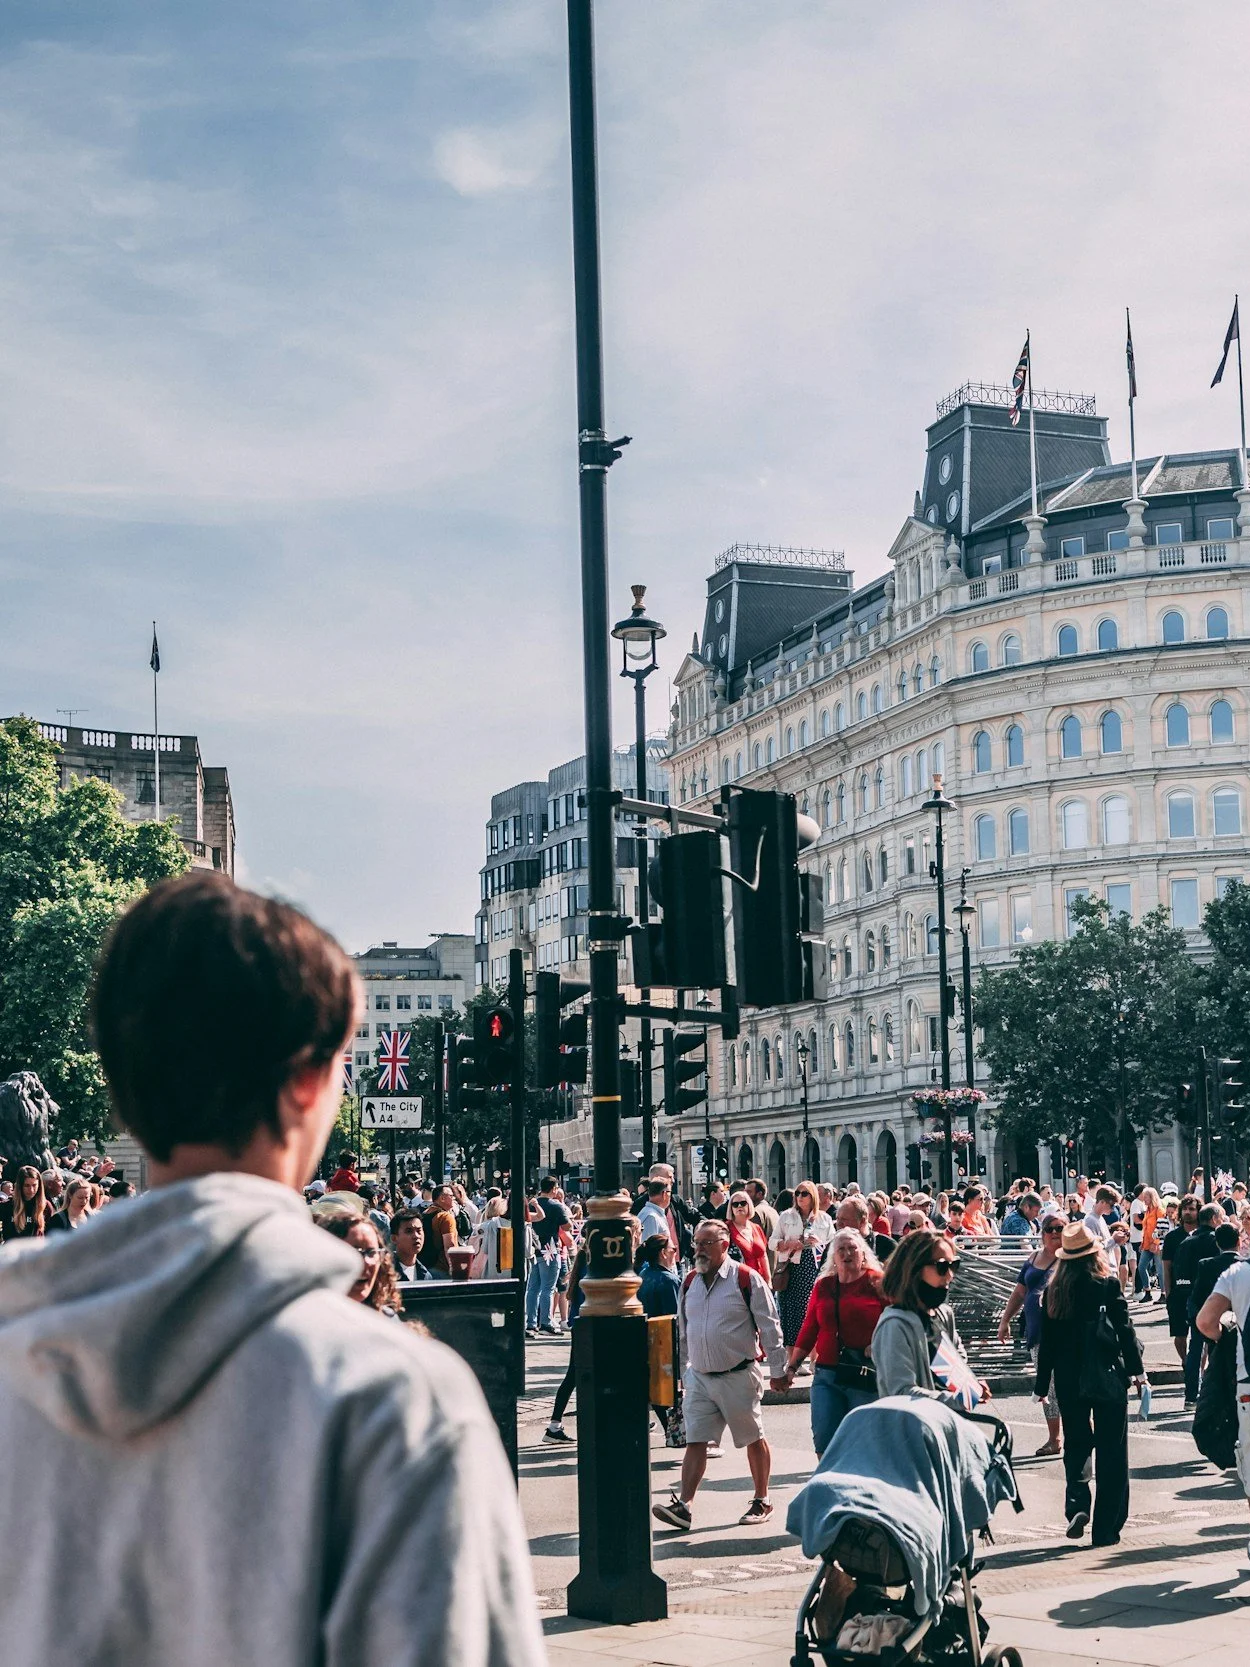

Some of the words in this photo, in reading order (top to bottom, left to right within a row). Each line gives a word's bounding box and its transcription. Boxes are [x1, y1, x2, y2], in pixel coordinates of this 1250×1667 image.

[380, 1102, 396, 1111] The
[399, 1102, 419, 1112] City
[380, 1114, 394, 1123] A4
